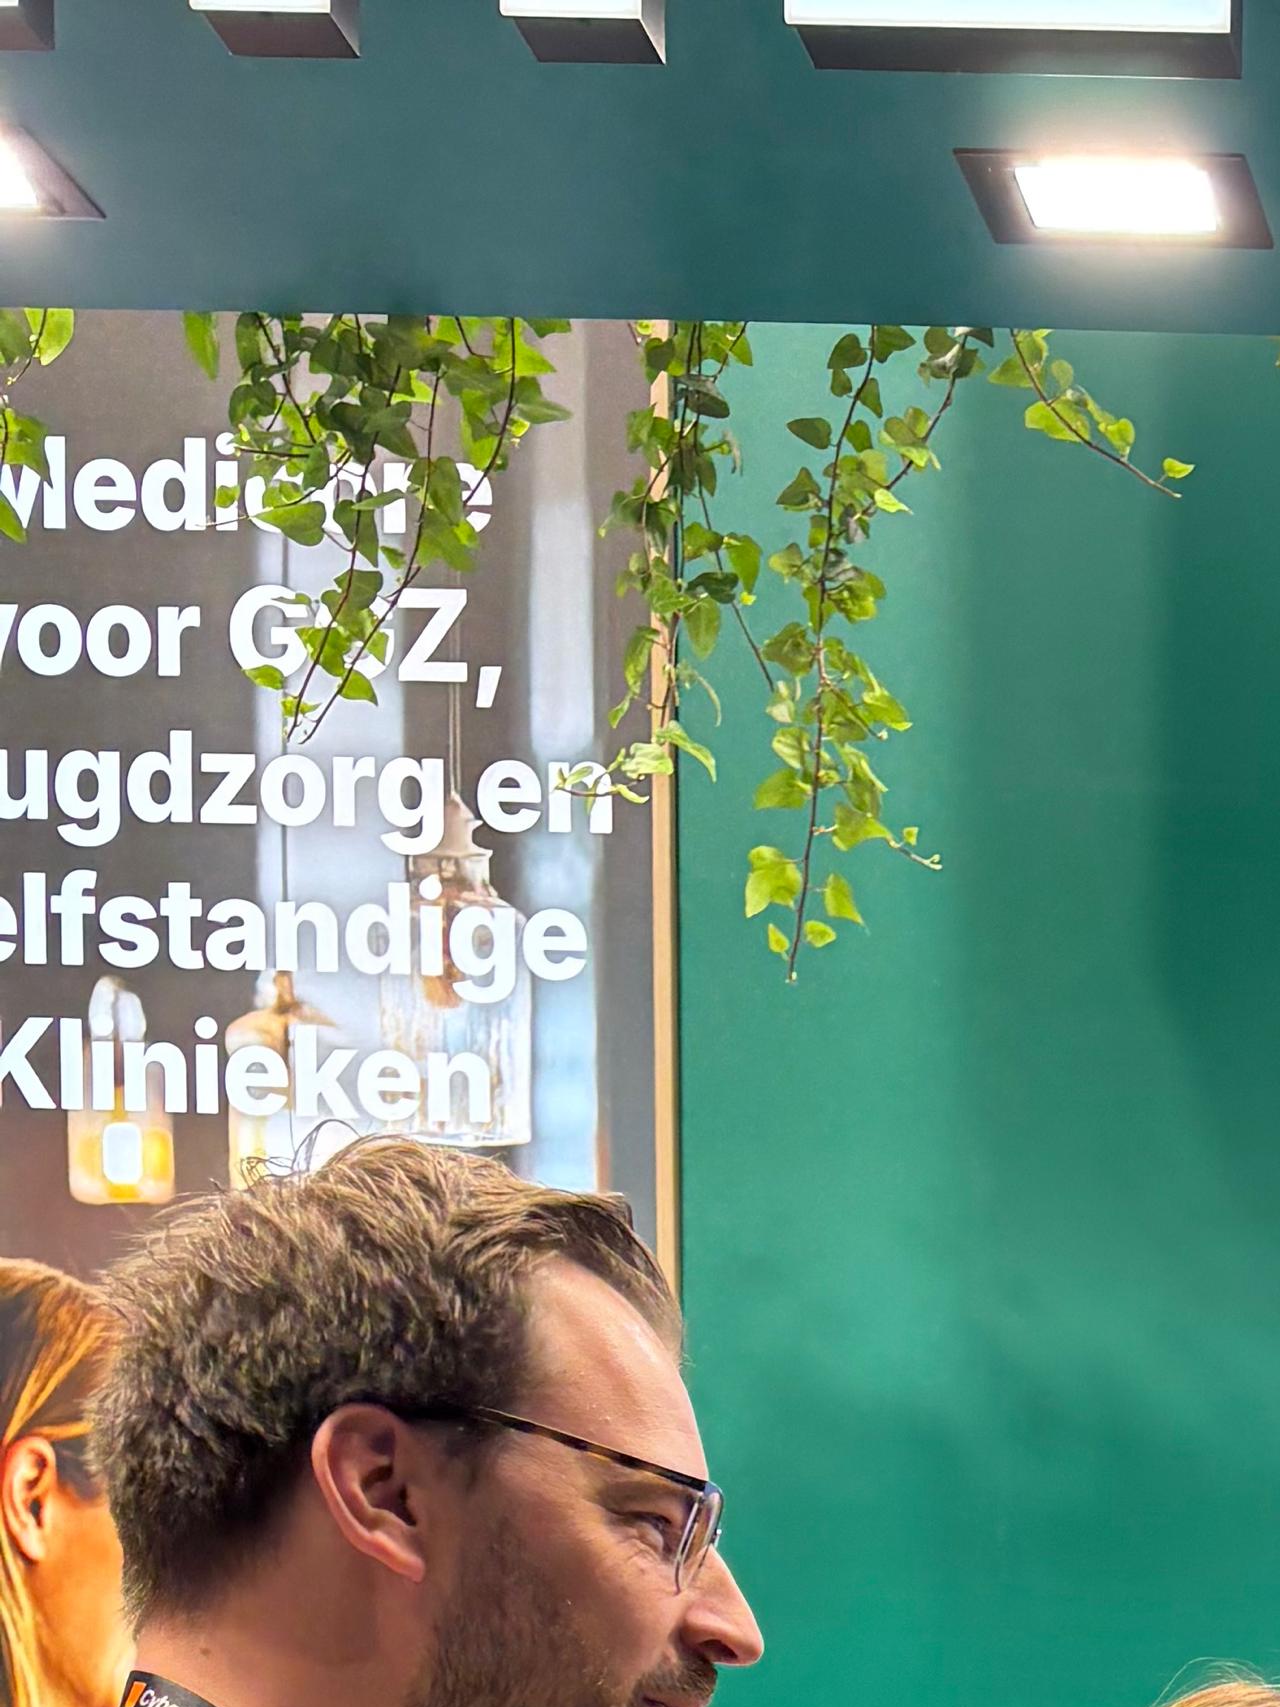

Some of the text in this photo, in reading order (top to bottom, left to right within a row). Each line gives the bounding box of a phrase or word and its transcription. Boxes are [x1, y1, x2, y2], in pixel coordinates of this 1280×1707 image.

[0, 602, 201, 678] oor
[476, 756, 615, 835] en
[0, 869, 589, 1003] lfstandige
[0, 1012, 493, 1124] Klinieken
